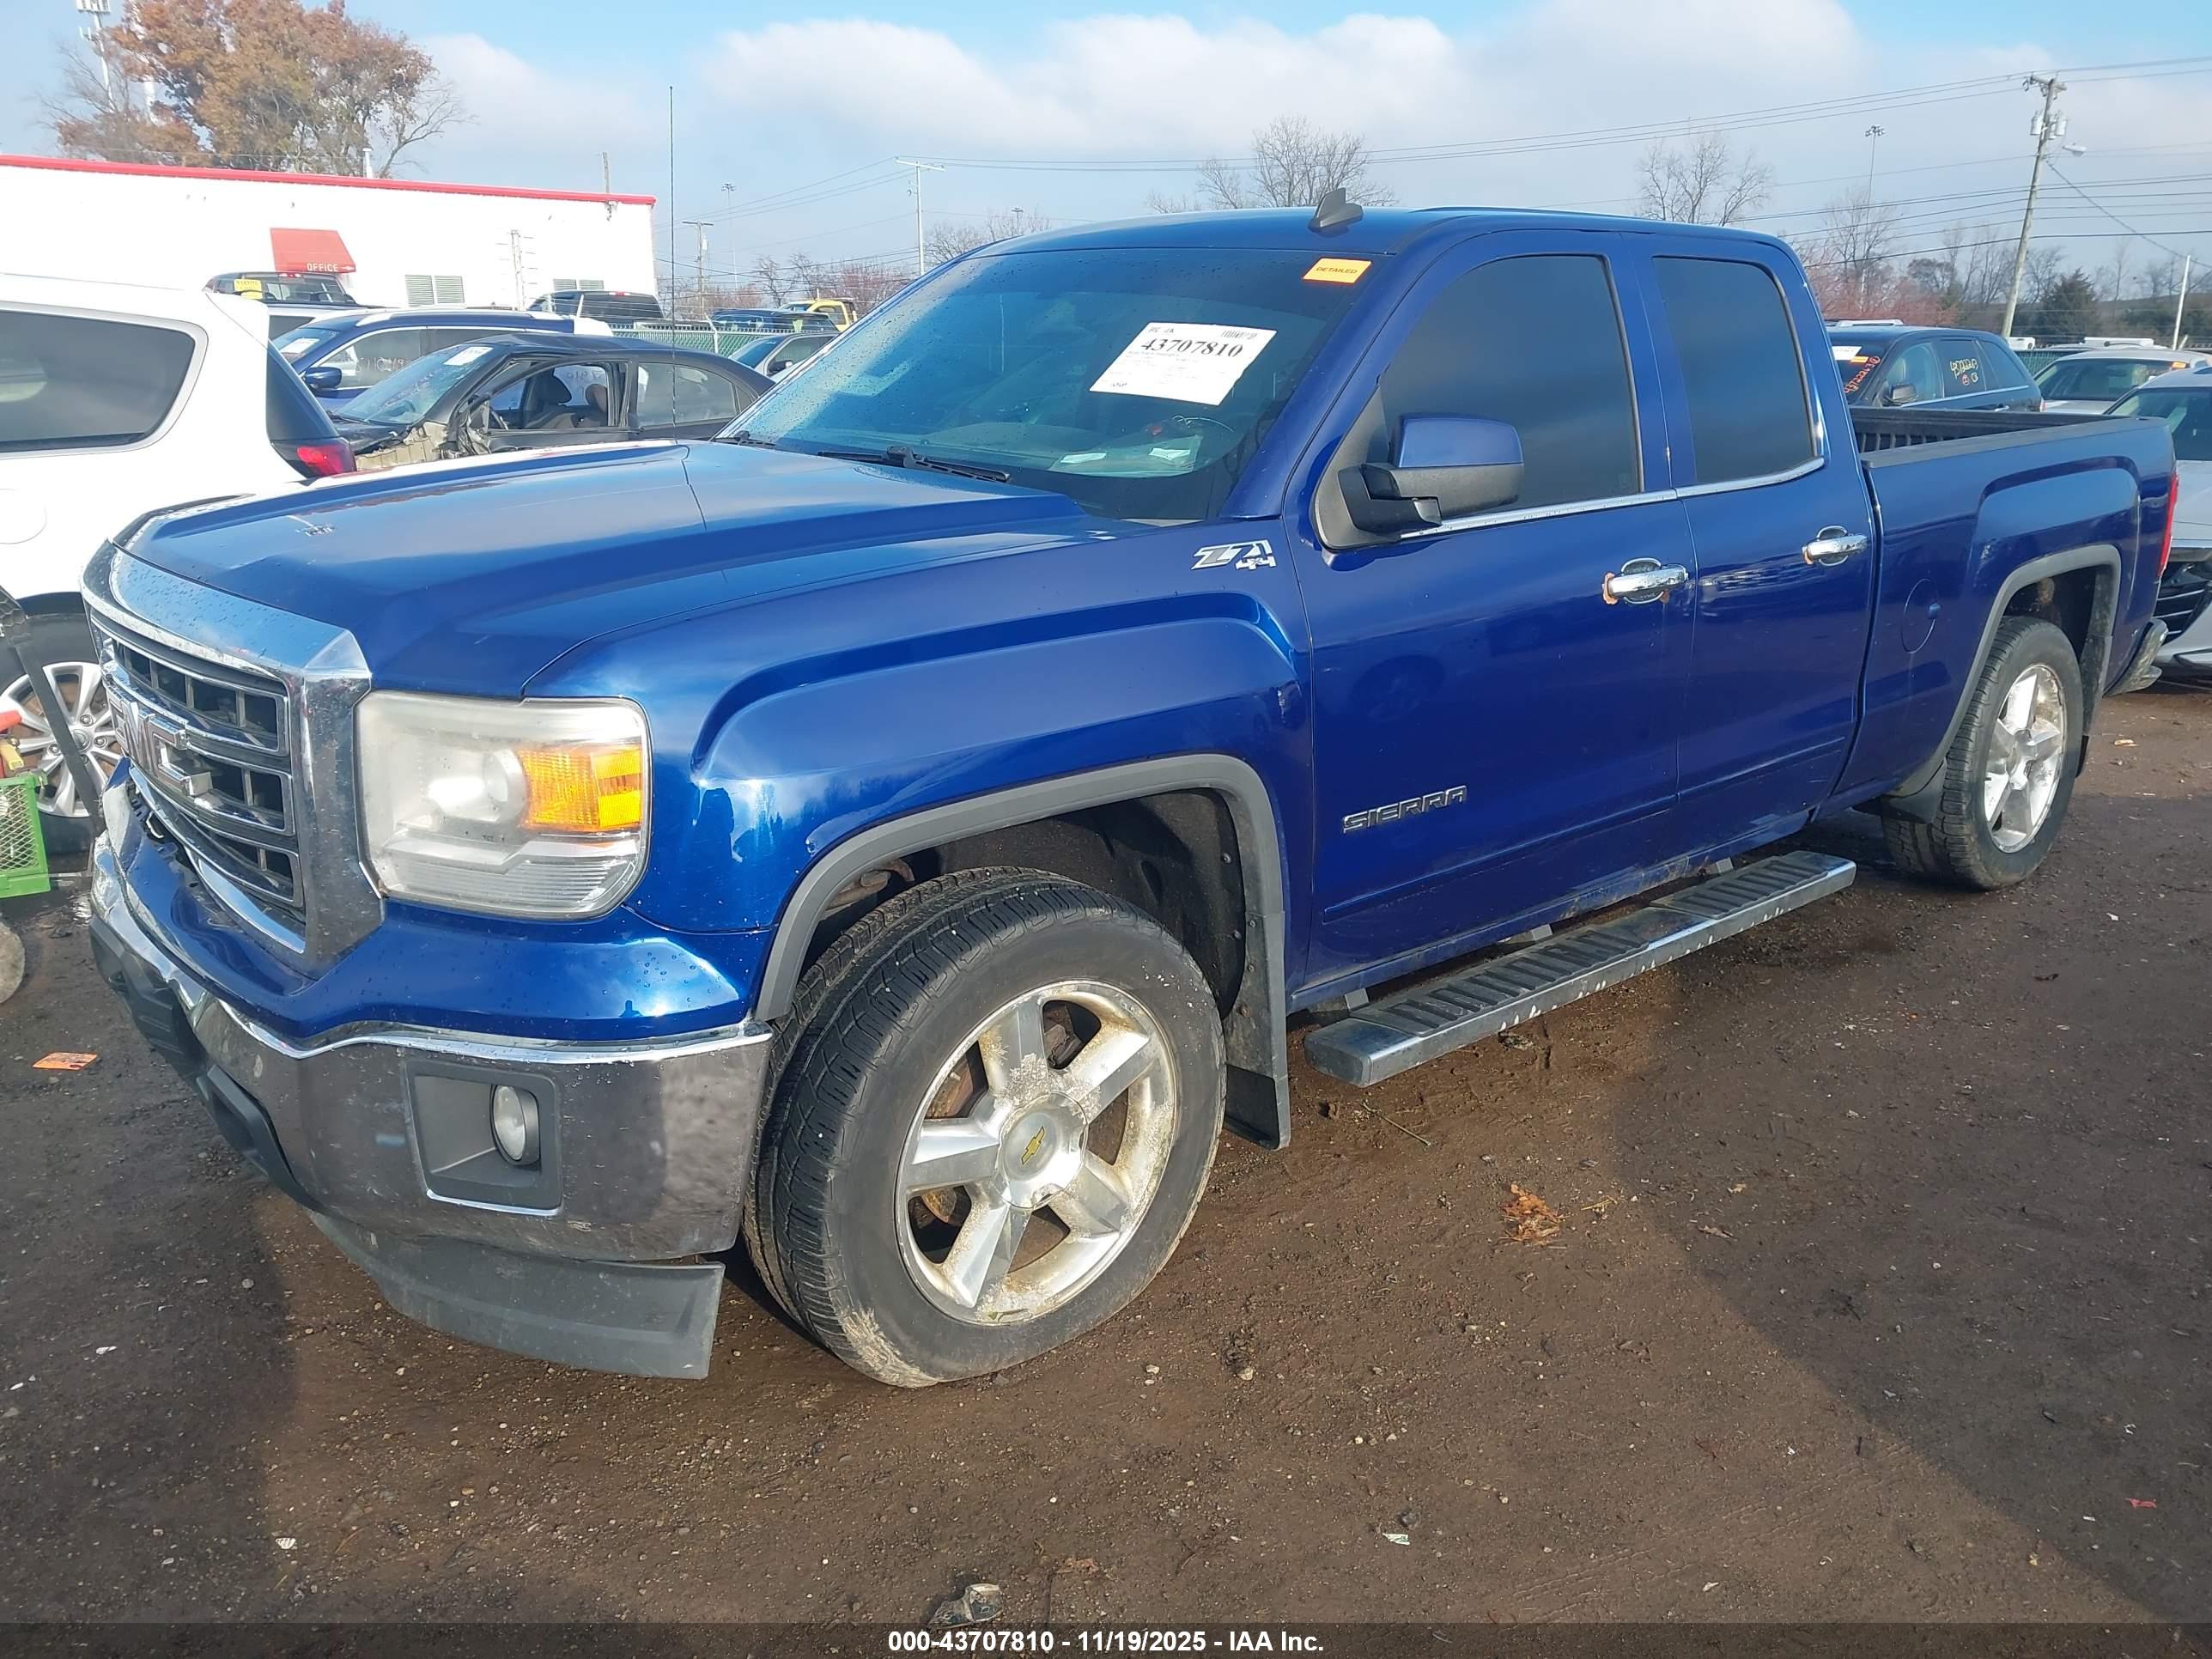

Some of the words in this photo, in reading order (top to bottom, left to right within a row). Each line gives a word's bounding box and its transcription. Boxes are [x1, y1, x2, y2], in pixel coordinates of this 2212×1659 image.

[307, 263, 339, 272] OFFICE
[1140, 337, 1243, 358] 43707810
[1341, 785, 1468, 835] SIERRA
